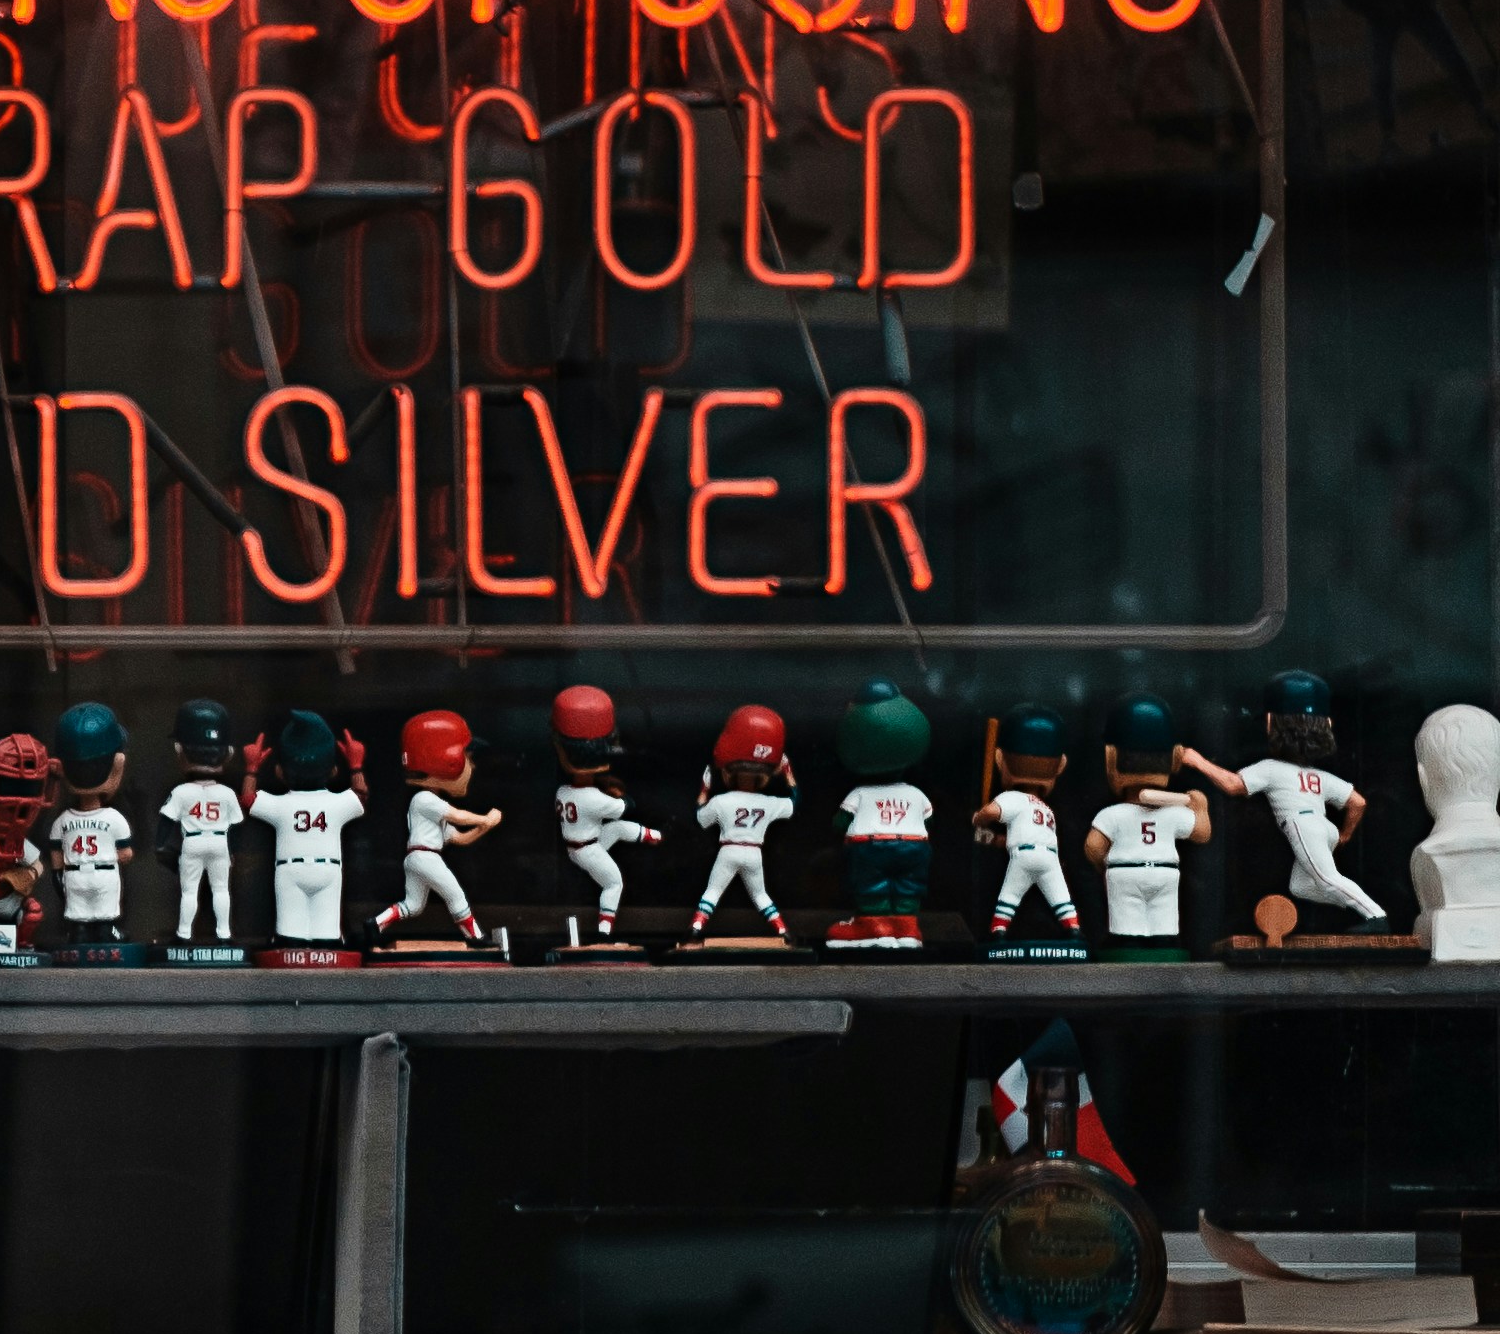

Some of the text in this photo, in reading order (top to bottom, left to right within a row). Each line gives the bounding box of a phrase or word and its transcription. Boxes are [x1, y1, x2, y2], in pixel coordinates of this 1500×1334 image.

[447, 86, 979, 295] GOLD
[244, 385, 934, 602] SILVER
[1297, 772, 1322, 796] 18
[189, 801, 221, 822] 45
[292, 810, 328, 833] 34
[734, 808, 766, 829] 27
[879, 809, 908, 827] 97
[62, 819, 112, 834] MARTINEZ
[1141, 821, 1157, 845] 5
[72, 835, 98, 856] 45
[0, 954, 39, 968] VARITEK
[283, 952, 338, 965] BIG PAPI
